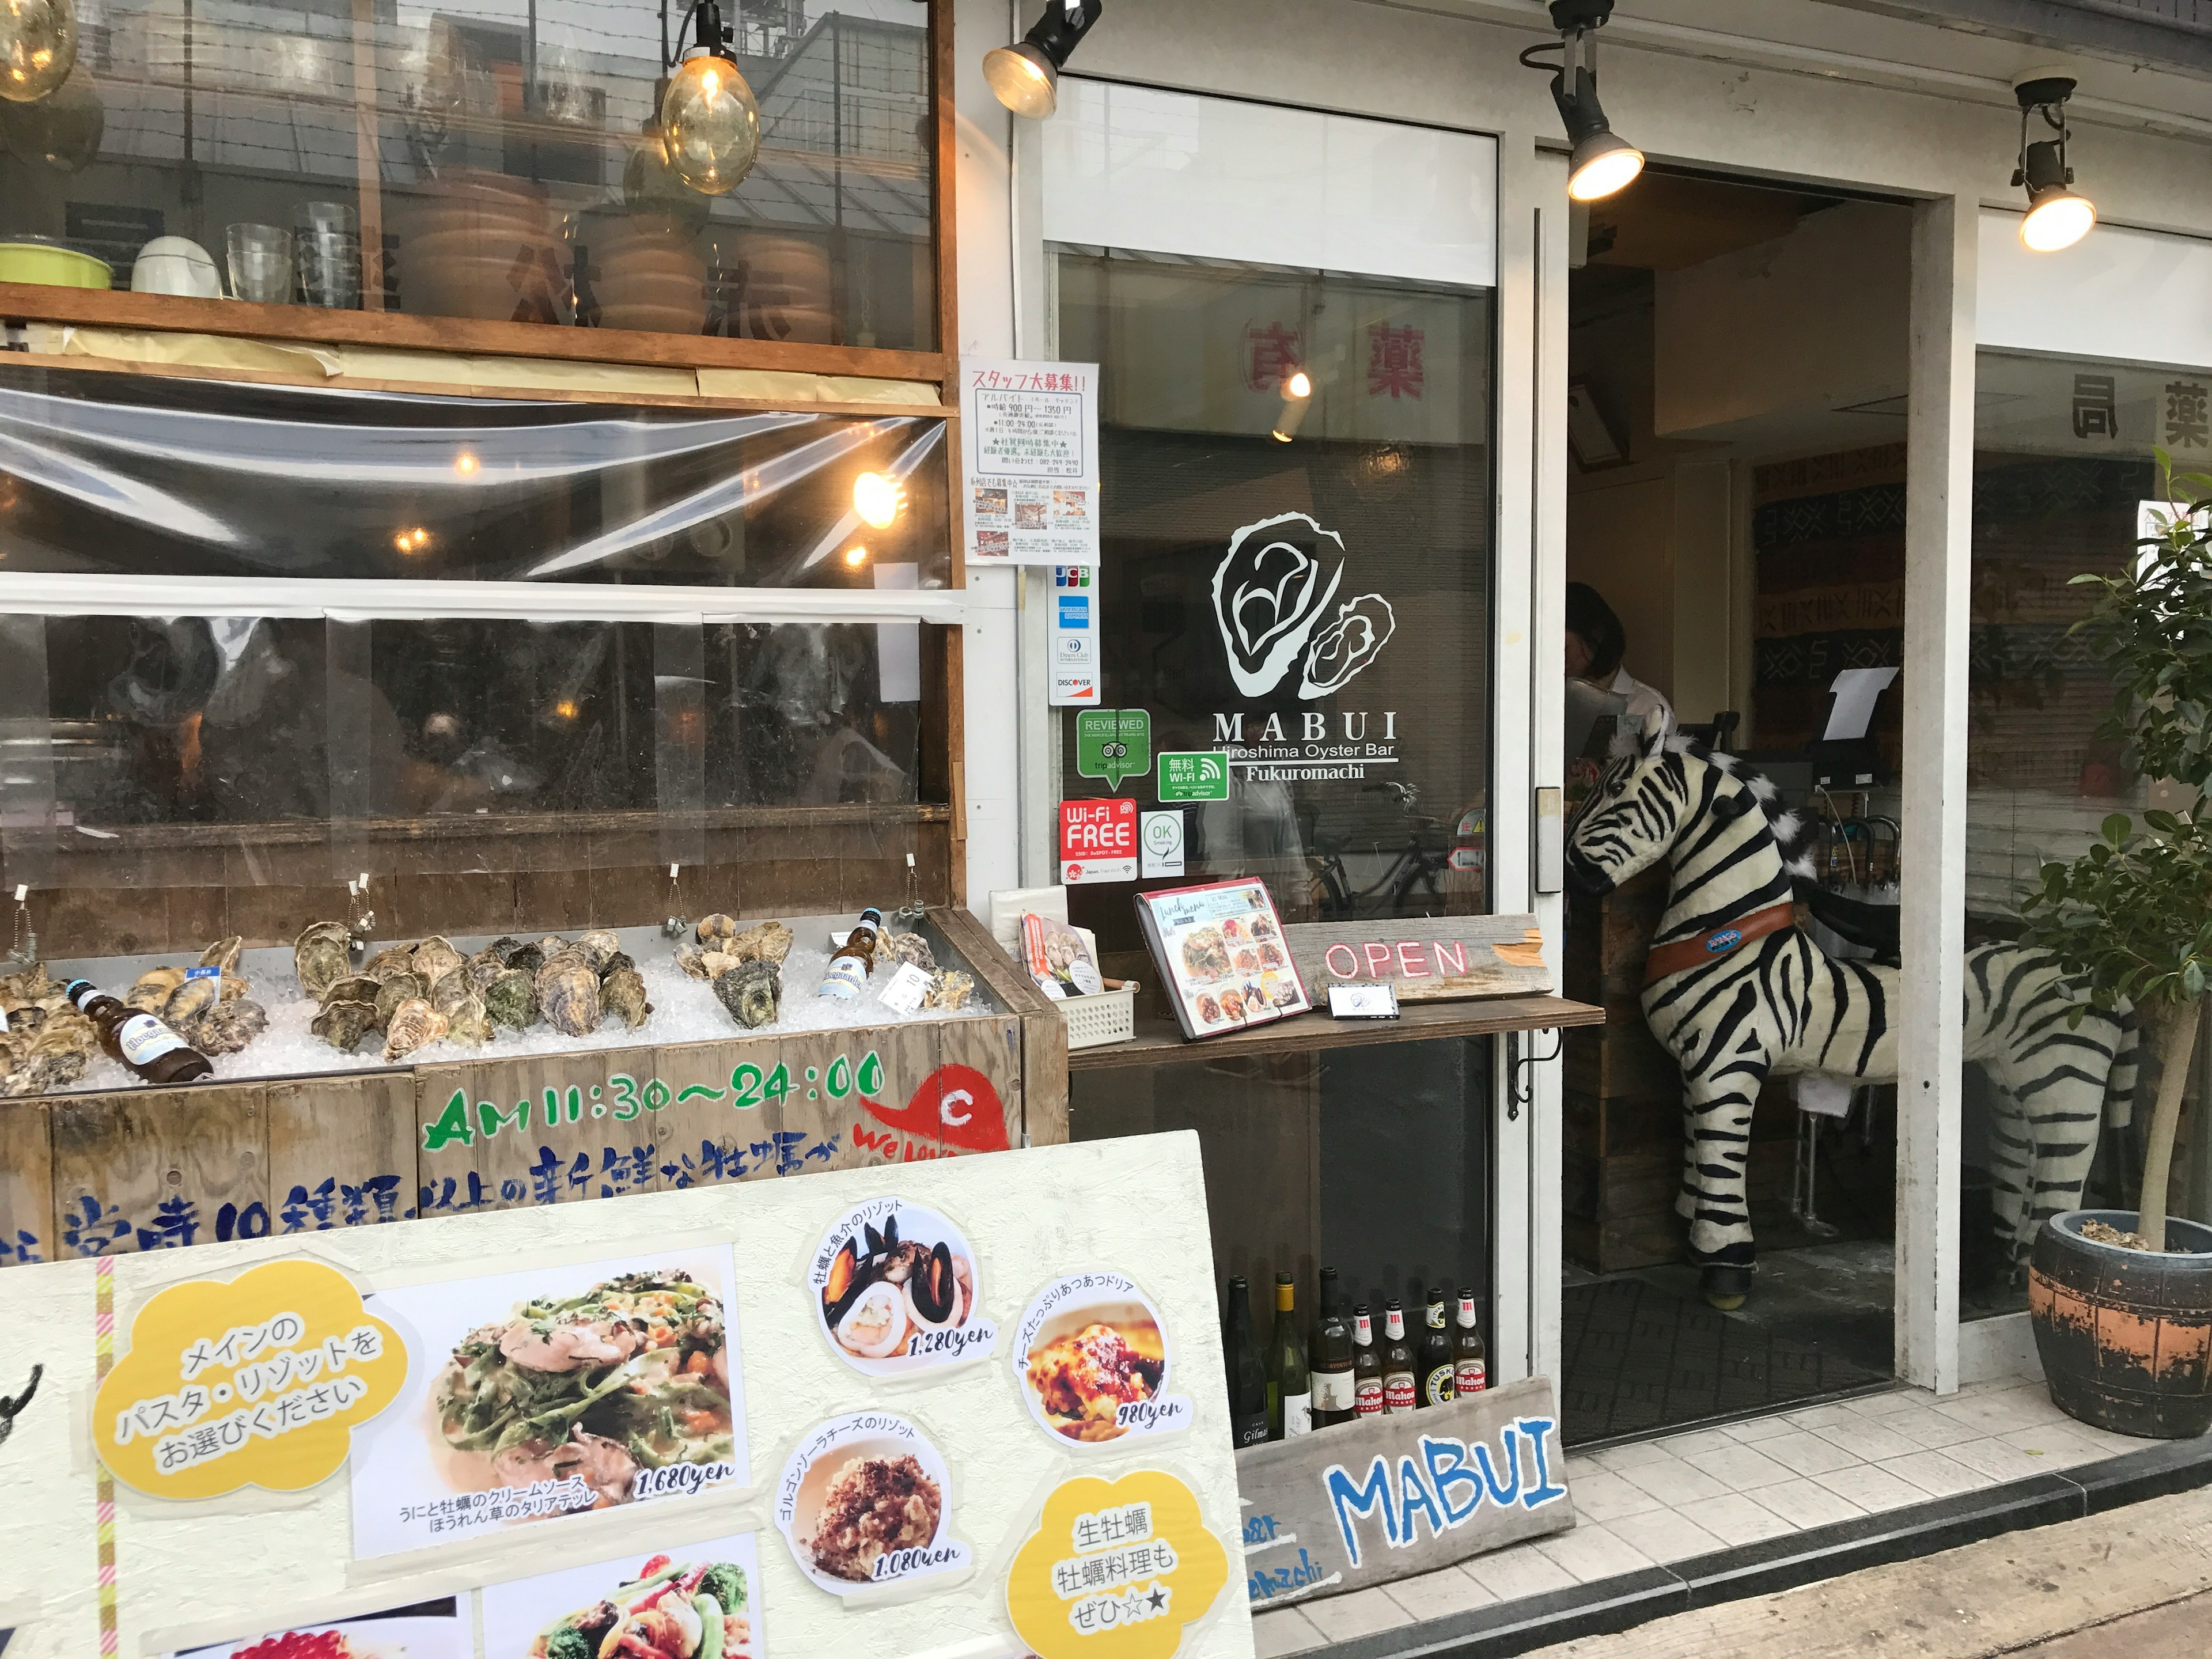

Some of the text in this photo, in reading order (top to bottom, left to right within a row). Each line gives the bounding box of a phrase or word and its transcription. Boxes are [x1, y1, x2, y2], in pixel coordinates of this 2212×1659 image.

[981, 394, 1024, 403] アルバイト
[1009, 404, 1022, 412] 900
[1045, 406, 1060, 414] 1350
[1056, 568, 1089, 579] JCB
[1085, 719, 1144, 730] REVIEWED
[1213, 712, 1397, 742] MABUI
[1095, 761, 1134, 771] tripadvisor
[1169, 757, 1194, 772] 無料
[1305, 744, 1361, 760] Oyster
[1366, 743, 1395, 756] Bar
[1169, 772, 1195, 782] WI-FI
[1246, 764, 1365, 782] Fukuromachi
[1066, 806, 1110, 823] Wi-Fi
[1067, 823, 1130, 849] FREE
[1153, 825, 1172, 839] OK
[1160, 897, 1184, 921] Lunch
[1183, 900, 1205, 915] menu
[1325, 941, 1468, 979] OPEN
[422, 1087, 531, 1152] AM
[853, 1123, 899, 1159] We
[813, 1200, 903, 1285] 牡蠣と魚介のリゾット
[1018, 1274, 1134, 1370] チーズたっぷりあつあつドリア
[186, 1317, 298, 1375] メインの
[909, 1327, 994, 1357] 1,280yen
[122, 1331, 378, 1440] パスタ・リゾットを
[1456, 1375, 1485, 1386] Mahou
[160, 1382, 362, 1469] お選びください
[1119, 1402, 1183, 1429] 980yen
[638, 1462, 736, 1497] 1,680yen
[779, 1417, 915, 1521] ゴルゴンゾーラチーズのリゾット
[399, 1475, 585, 1524] うにと牡蠣のクリームソース
[1324, 1416, 1567, 1569] MABUI
[429, 1490, 599, 1533] ほうれん草のタリアテッレ
[1077, 1508, 1147, 1547] 生牡蠣
[1057, 1544, 1173, 1593] 牡蠣料理も
